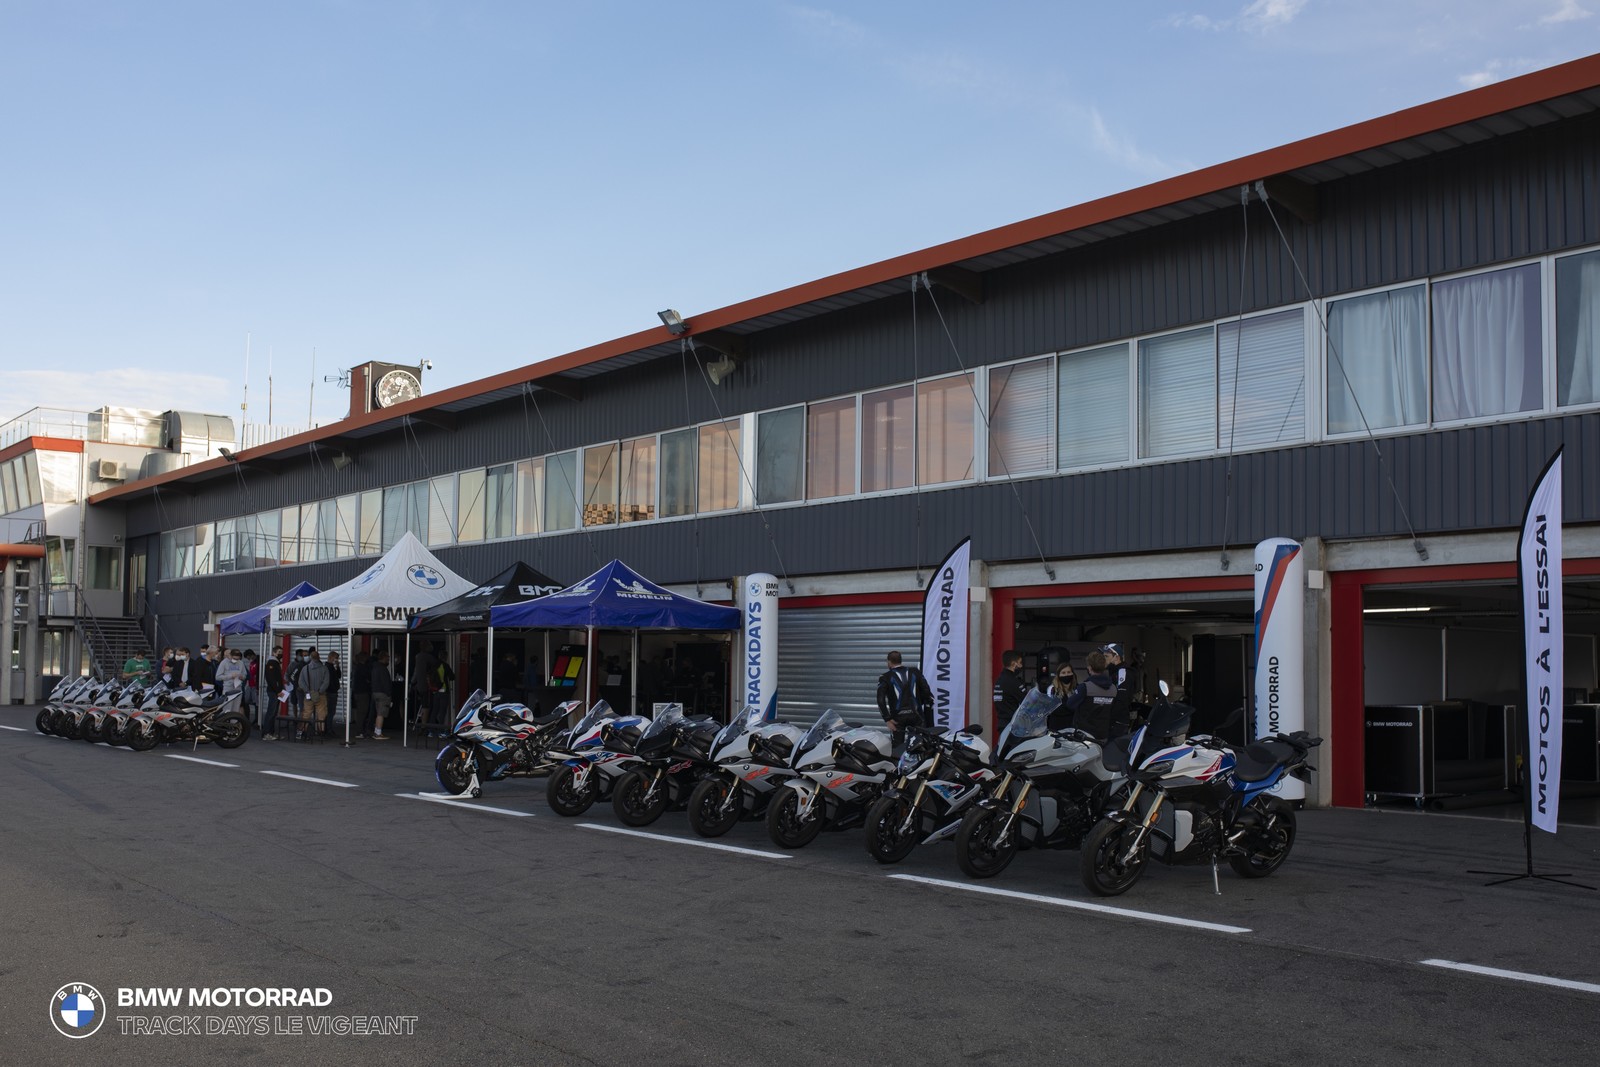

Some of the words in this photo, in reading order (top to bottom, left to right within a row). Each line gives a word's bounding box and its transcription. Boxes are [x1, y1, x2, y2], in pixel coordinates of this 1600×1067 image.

[616, 592, 673, 601] MICHELIN
[1536, 514, 1550, 634] L'ESSAI
[278, 607, 297, 621] BMW
[298, 606, 340, 621] MOTORRAD
[936, 566, 954, 682] MOTORRAD
[1536, 648, 1551, 672] À
[936, 685, 951, 727] MW
[1268, 656, 1279, 733] MOTORRAD
[1537, 686, 1551, 814] MOTOS
